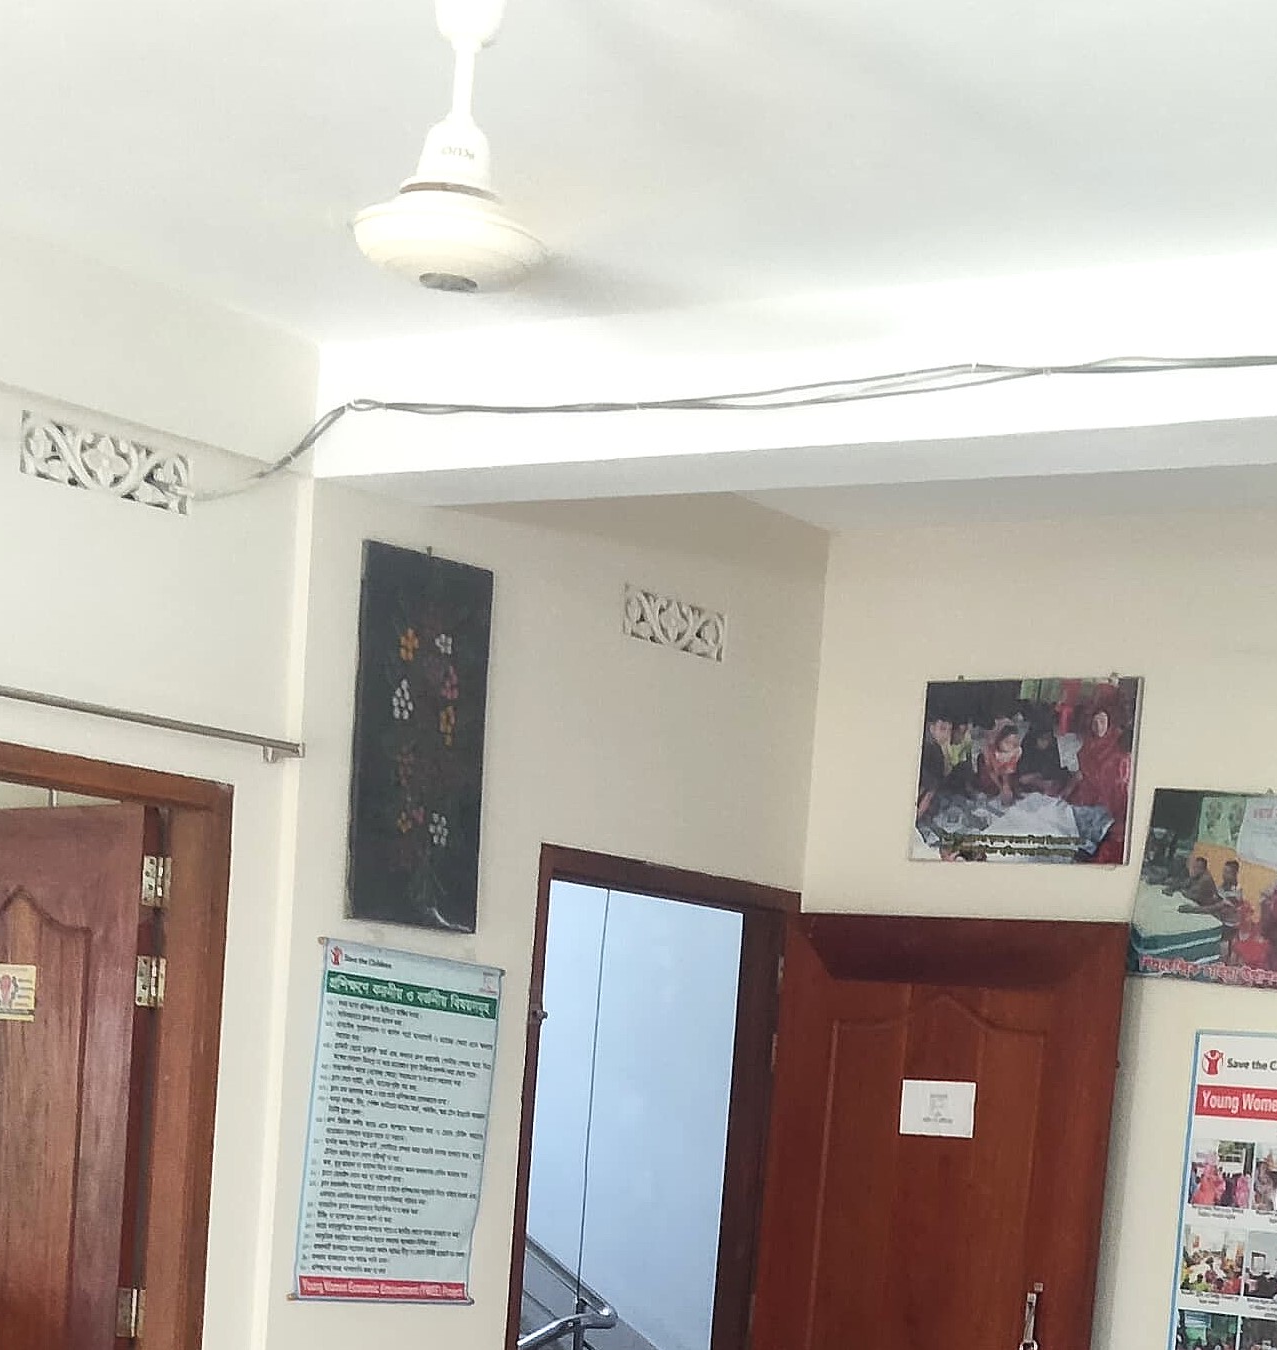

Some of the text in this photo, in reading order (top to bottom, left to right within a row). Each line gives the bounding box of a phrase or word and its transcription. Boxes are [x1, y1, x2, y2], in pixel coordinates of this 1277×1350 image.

[1227, 1057, 1250, 1069] Save
[1252, 1060, 1267, 1070] the
[1202, 1090, 1240, 1115] Young
